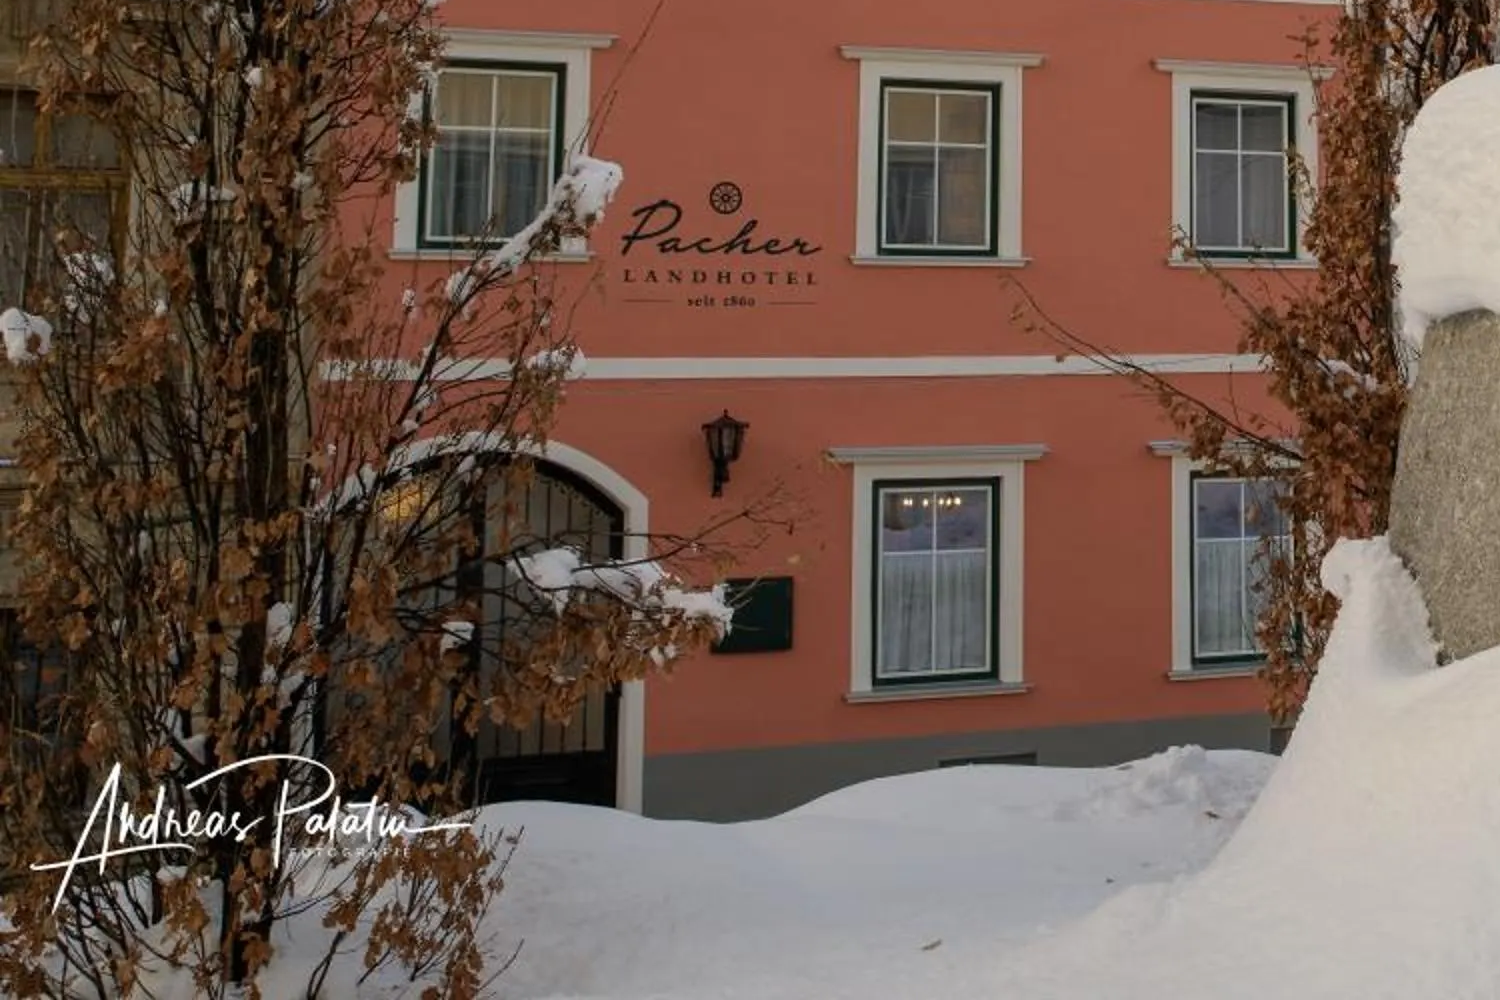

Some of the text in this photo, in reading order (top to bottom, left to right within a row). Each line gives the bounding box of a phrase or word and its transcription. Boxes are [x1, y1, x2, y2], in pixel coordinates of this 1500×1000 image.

[621, 199, 823, 256] Pacher
[624, 269, 818, 286] LANDHOTEL
[687, 295, 715, 307] seit
